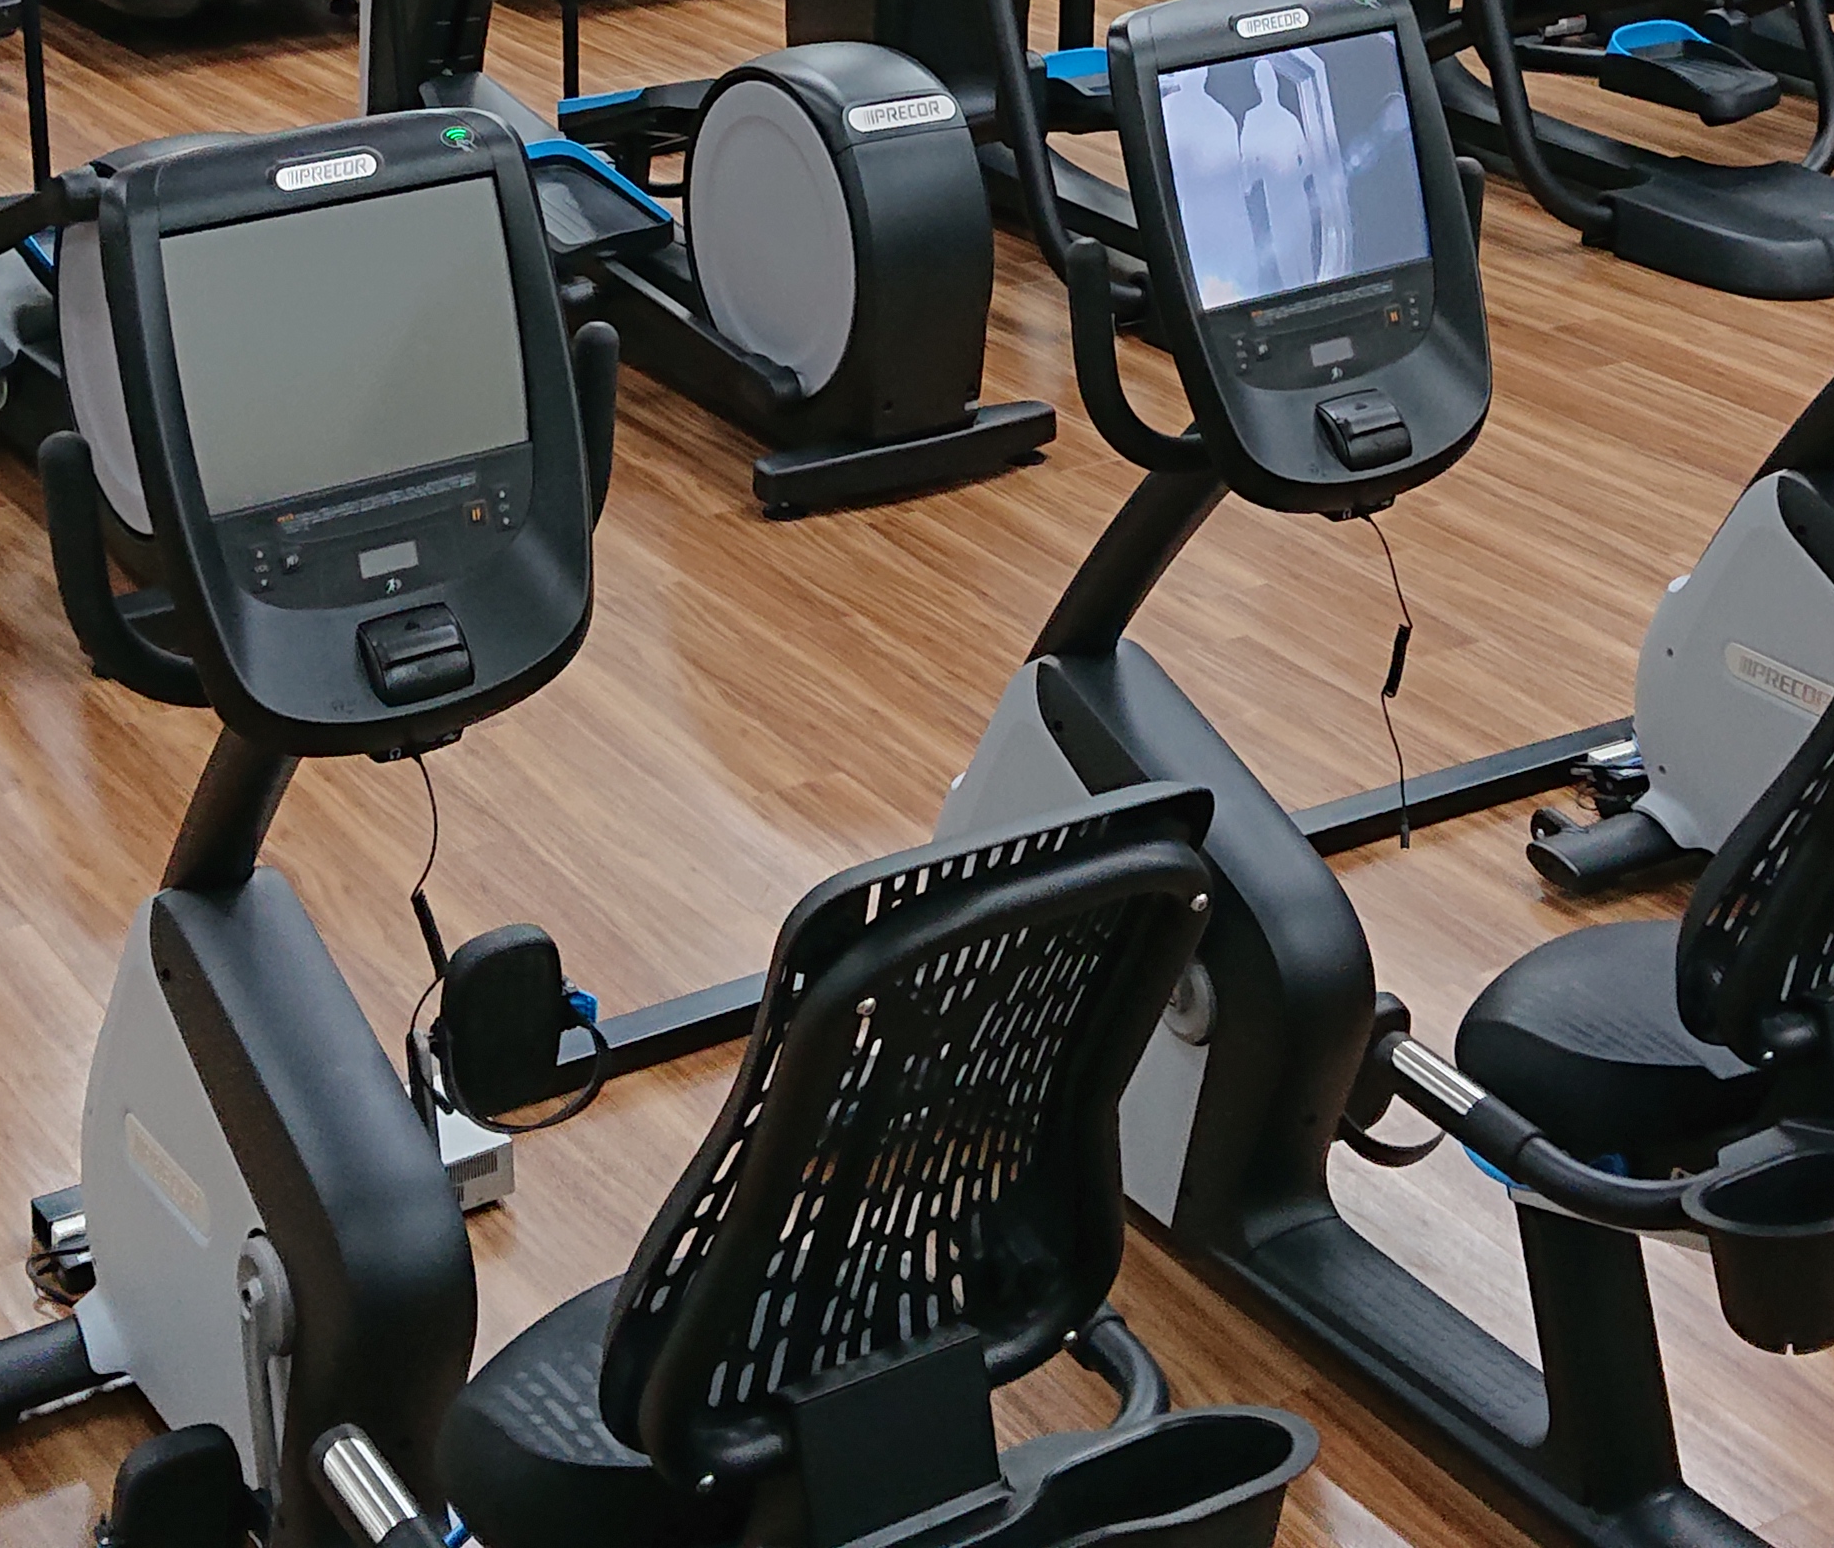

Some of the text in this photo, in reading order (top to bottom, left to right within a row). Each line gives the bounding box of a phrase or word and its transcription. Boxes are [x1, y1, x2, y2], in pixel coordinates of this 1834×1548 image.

[1253, 12, 1303, 33] PRECOR
[874, 100, 941, 124] PRECOR
[300, 157, 368, 185] PRECOR
